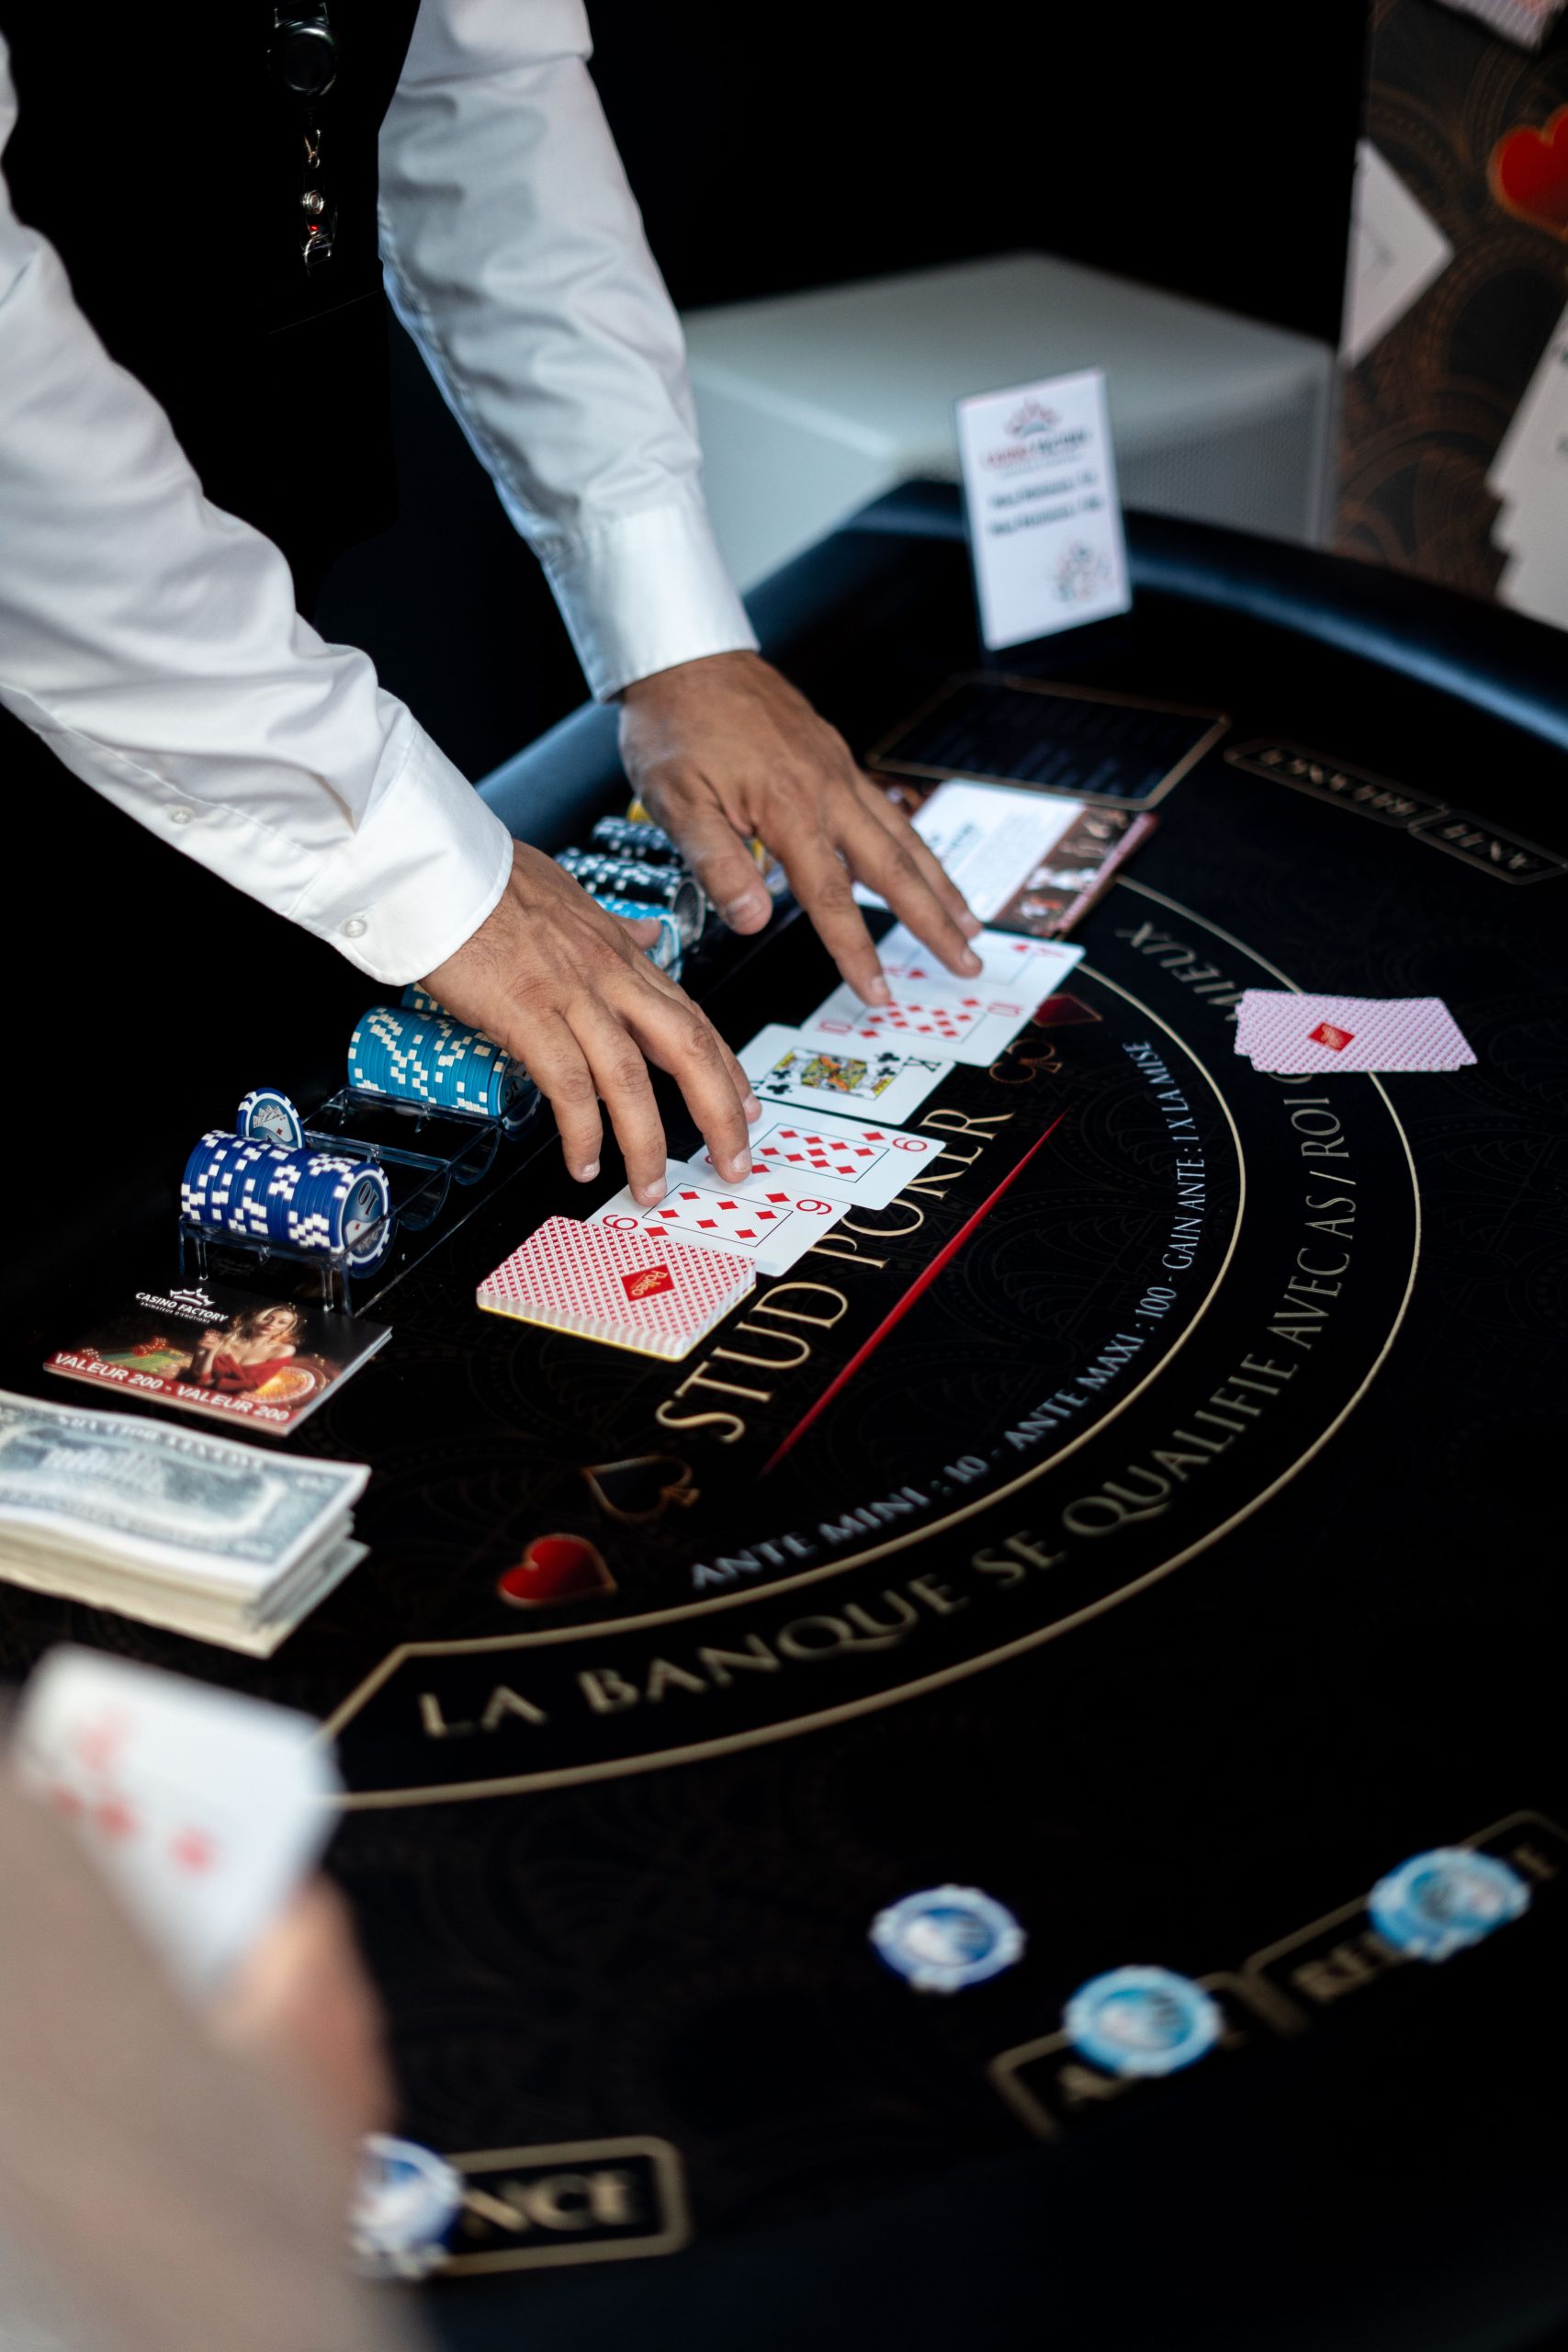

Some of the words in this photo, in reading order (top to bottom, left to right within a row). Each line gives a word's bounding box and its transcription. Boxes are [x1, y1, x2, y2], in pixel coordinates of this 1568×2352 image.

[903, 1054, 942, 1074] K
[1121, 1040, 1177, 1085] MISE
[1156, 1088, 1190, 1112] LA
[1166, 1117, 1197, 1130] X
[1282, 1097, 1350, 1159] ROI
[358, 1181, 379, 1216] 10
[1175, 1158, 1206, 1212] ANTE
[1161, 1216, 1203, 1270] GAIN
[1303, 1194, 1358, 1241] AS
[135, 1292, 178, 1308] CASINO
[177, 1304, 230, 1322] FACTORY
[140, 1302, 175, 1314] ANIMATEUR
[1134, 1285, 1178, 1320] 100
[1265, 1247, 1351, 1351] AVEC
[53, 1351, 130, 1382] VALEUR
[129, 1374, 164, 1392] 200
[175, 1384, 254, 1416] VALEUR
[253, 1405, 290, 1422] 200
[654, 1281, 850, 1445] STUD
[1074, 1332, 1146, 1392] MAXI
[1003, 1387, 1089, 1453] ANTE
[1060, 1352, 1302, 1539] QUALIFIE
[942, 1454, 992, 1486] 10
[817, 1486, 933, 1547] MINI
[691, 1532, 819, 1591] ANTE
[969, 1528, 1071, 1593] SE
[575, 1571, 973, 1715] BANQUE
[416, 1682, 549, 1740] LA
